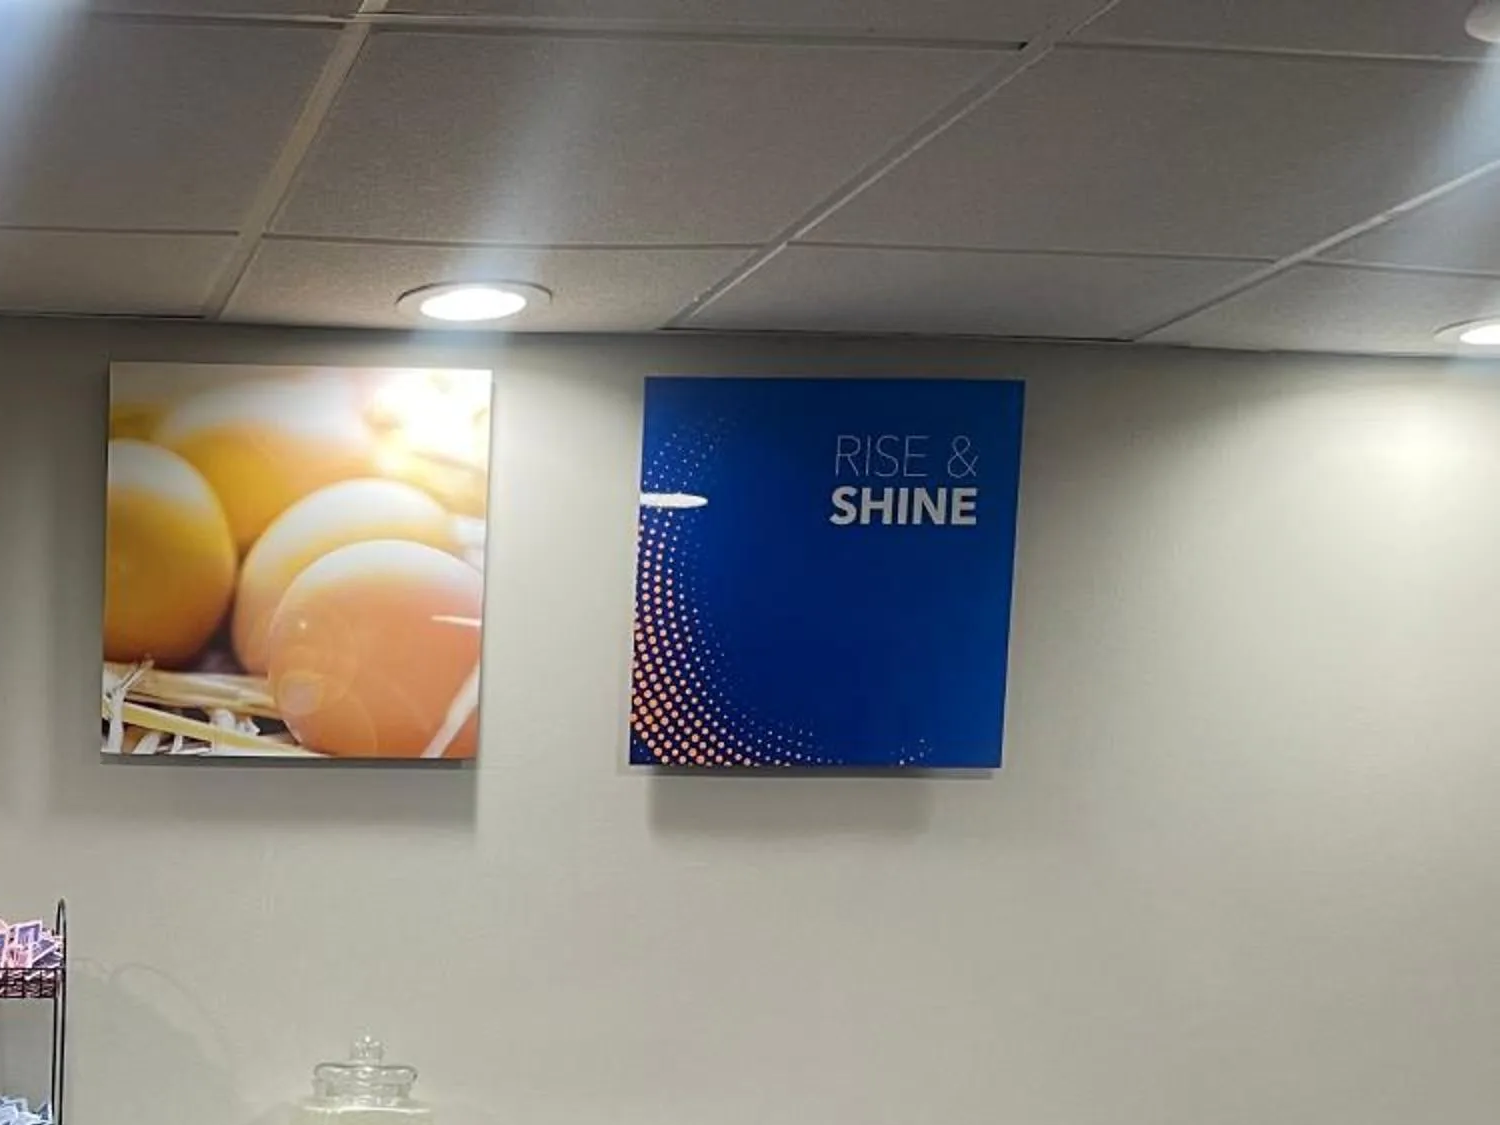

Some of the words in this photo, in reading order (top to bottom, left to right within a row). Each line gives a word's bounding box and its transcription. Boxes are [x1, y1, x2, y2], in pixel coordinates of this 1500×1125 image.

[833, 434, 930, 478] RISE
[946, 434, 979, 479] &
[829, 485, 978, 526] SHINE
